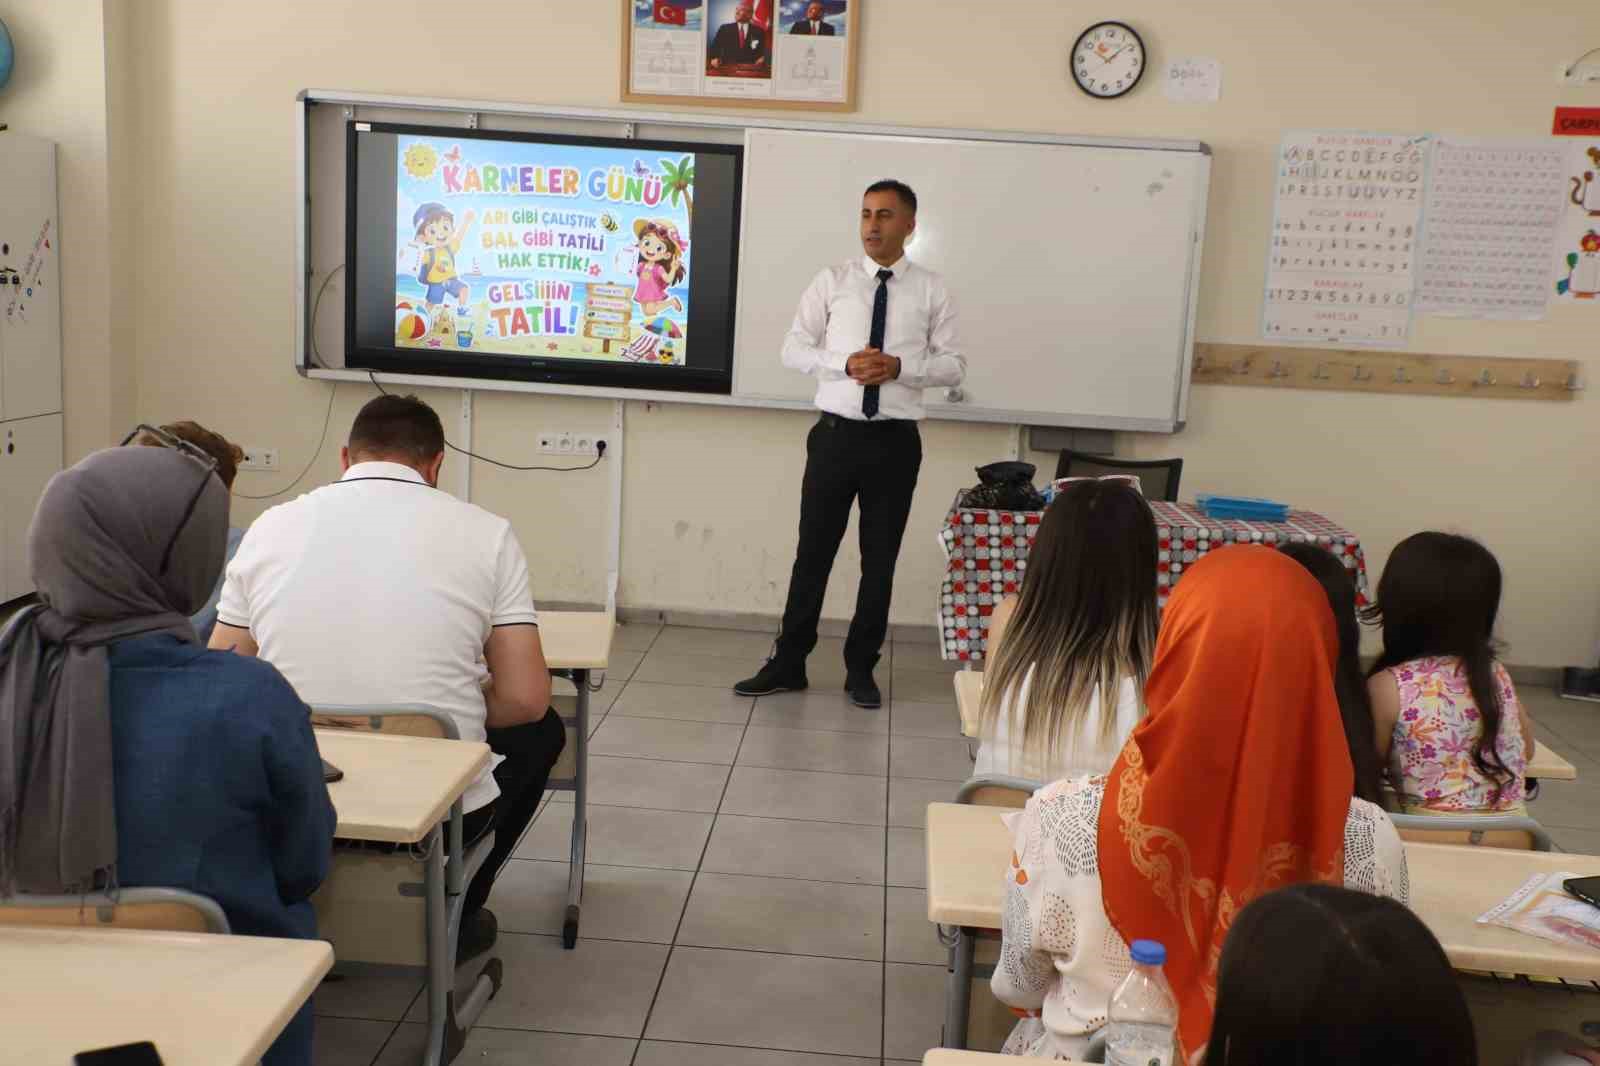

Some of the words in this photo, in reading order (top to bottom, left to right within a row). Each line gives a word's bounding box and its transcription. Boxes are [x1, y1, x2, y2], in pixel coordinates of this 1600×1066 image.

[442, 165, 580, 194] KARNELER
[588, 166, 663, 206] GÜNÜ
[482, 210, 508, 225] ARI
[512, 208, 539, 224] GİBİ
[542, 211, 597, 229] ÇALIŞTIK
[482, 231, 517, 248] BAL
[522, 229, 554, 246] GİBİ
[558, 232, 605, 252] TATİLİ
[498, 253, 532, 269] HAK
[537, 252, 590, 272] ETTİK!
[490, 301, 579, 337] TATİL!
